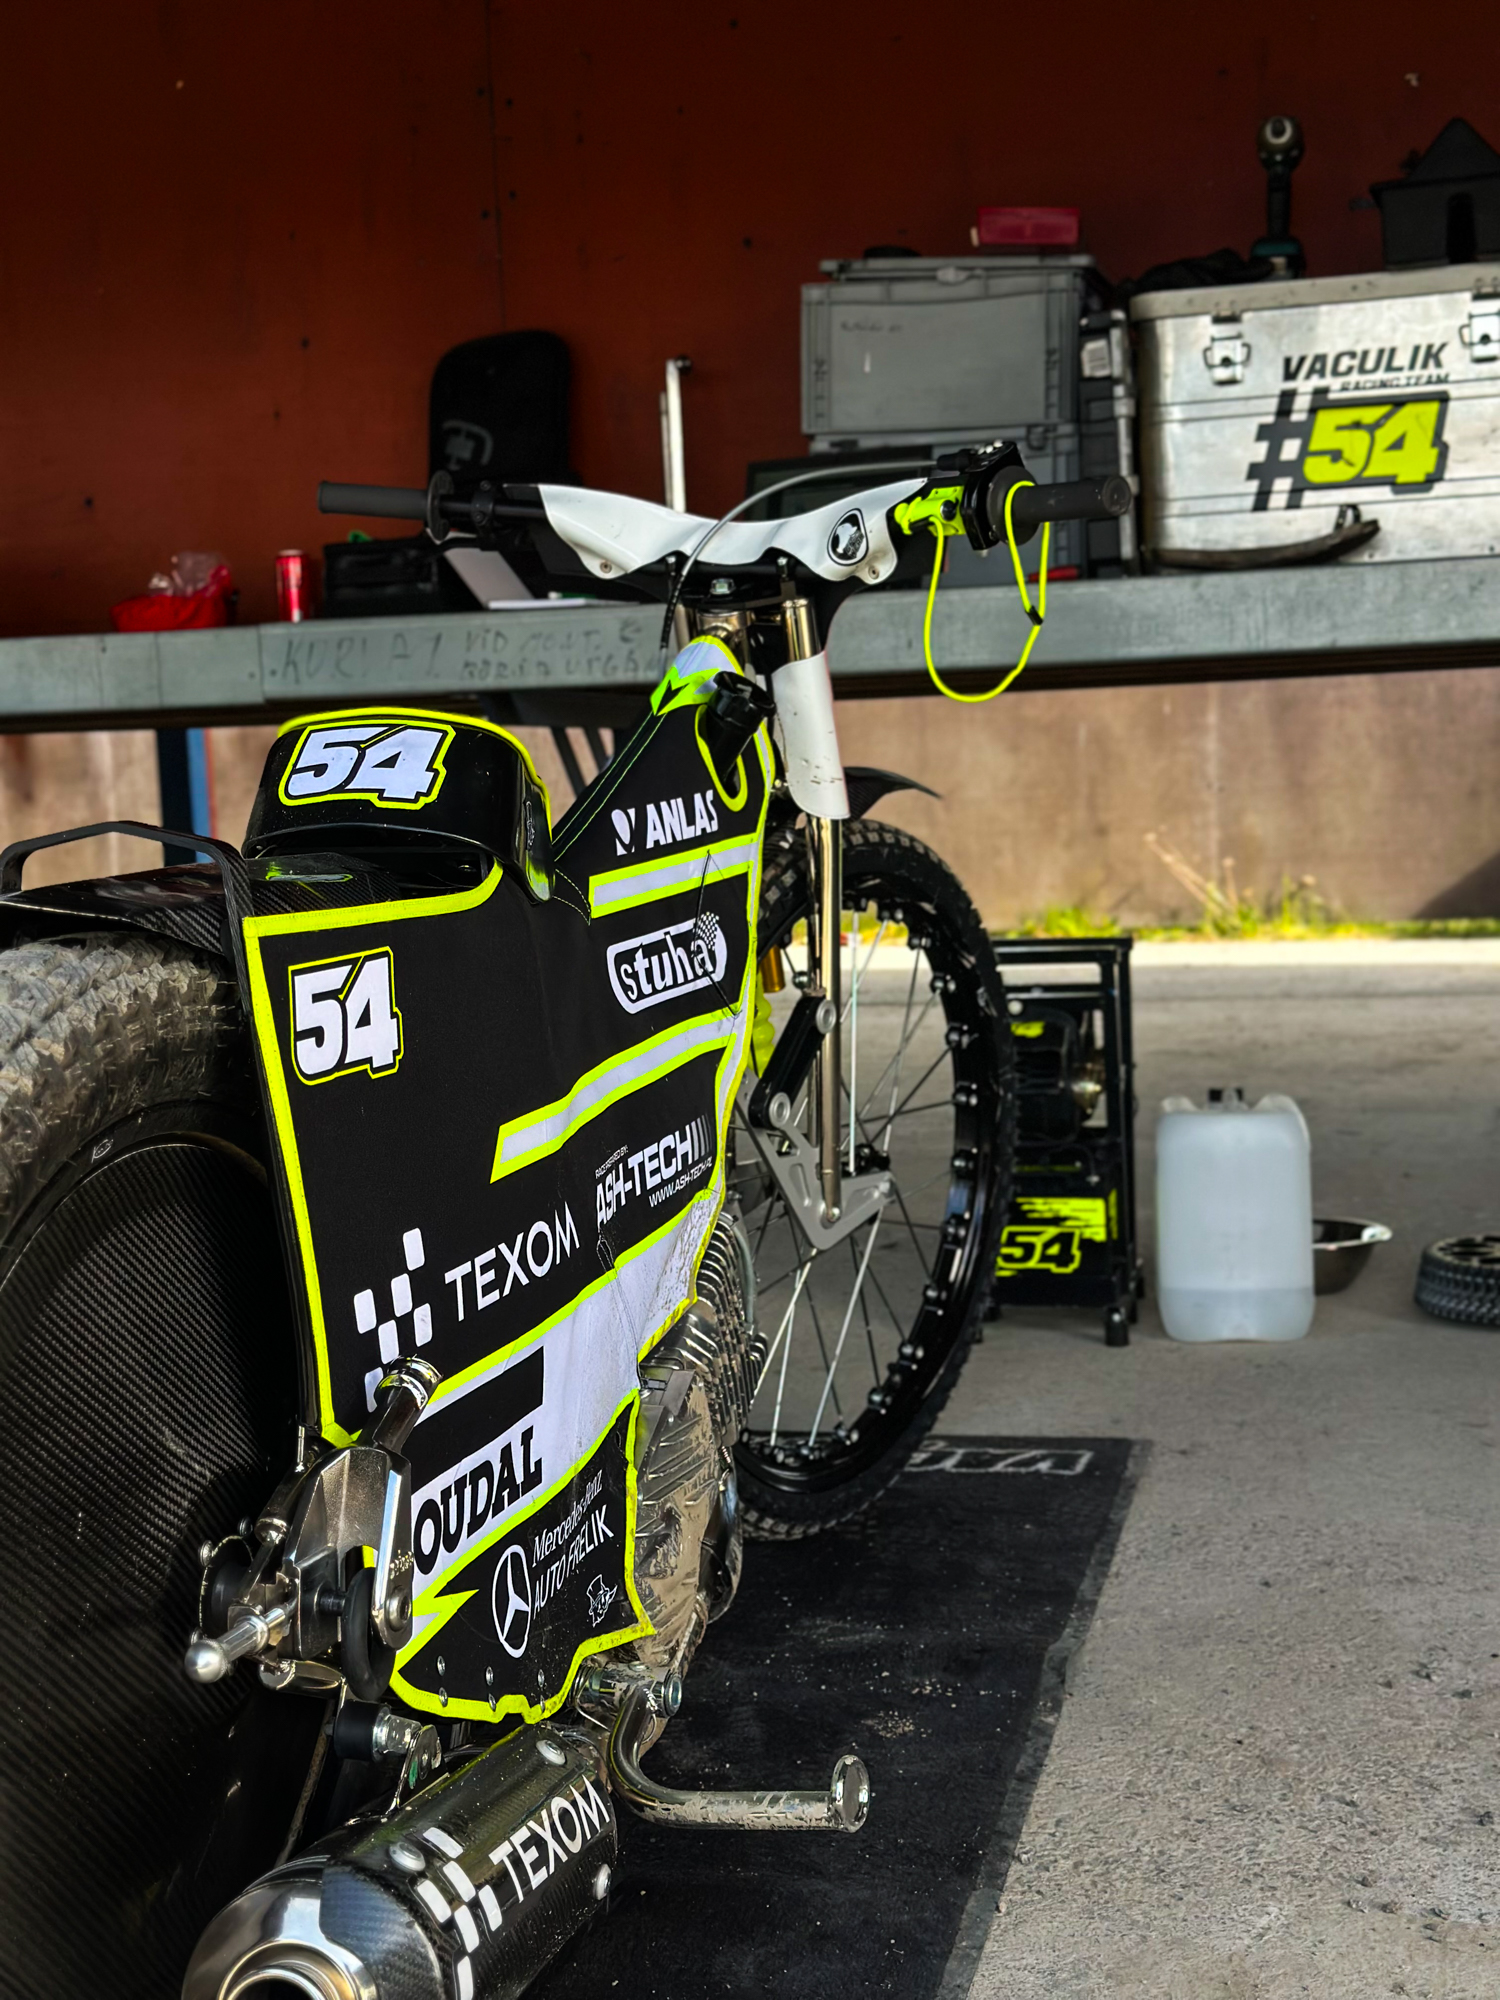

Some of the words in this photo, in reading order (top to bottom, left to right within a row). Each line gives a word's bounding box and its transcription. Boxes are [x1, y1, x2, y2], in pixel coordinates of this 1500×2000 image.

[1282, 342, 1449, 382] VACULIK
[1340, 376, 1401, 391] RACING
[1405, 372, 1450, 386] TEAM
[1246, 389, 1450, 511] #54
[285, 725, 446, 803] 54
[646, 790, 718, 849] ANLAS
[292, 954, 400, 1077] 54
[620, 932, 714, 1000] stuha
[596, 1124, 693, 1226] ASH-TECH
[444, 1201, 581, 1321] TEXOM
[998, 1227, 1081, 1272] 54
[413, 1425, 543, 1575] OUDAL
[532, 1469, 603, 1567] Mercedes-Benz
[533, 1553, 567, 1618] AUTO
[566, 1504, 615, 1578] FRELIK
[489, 1775, 611, 1903] TEXOM
